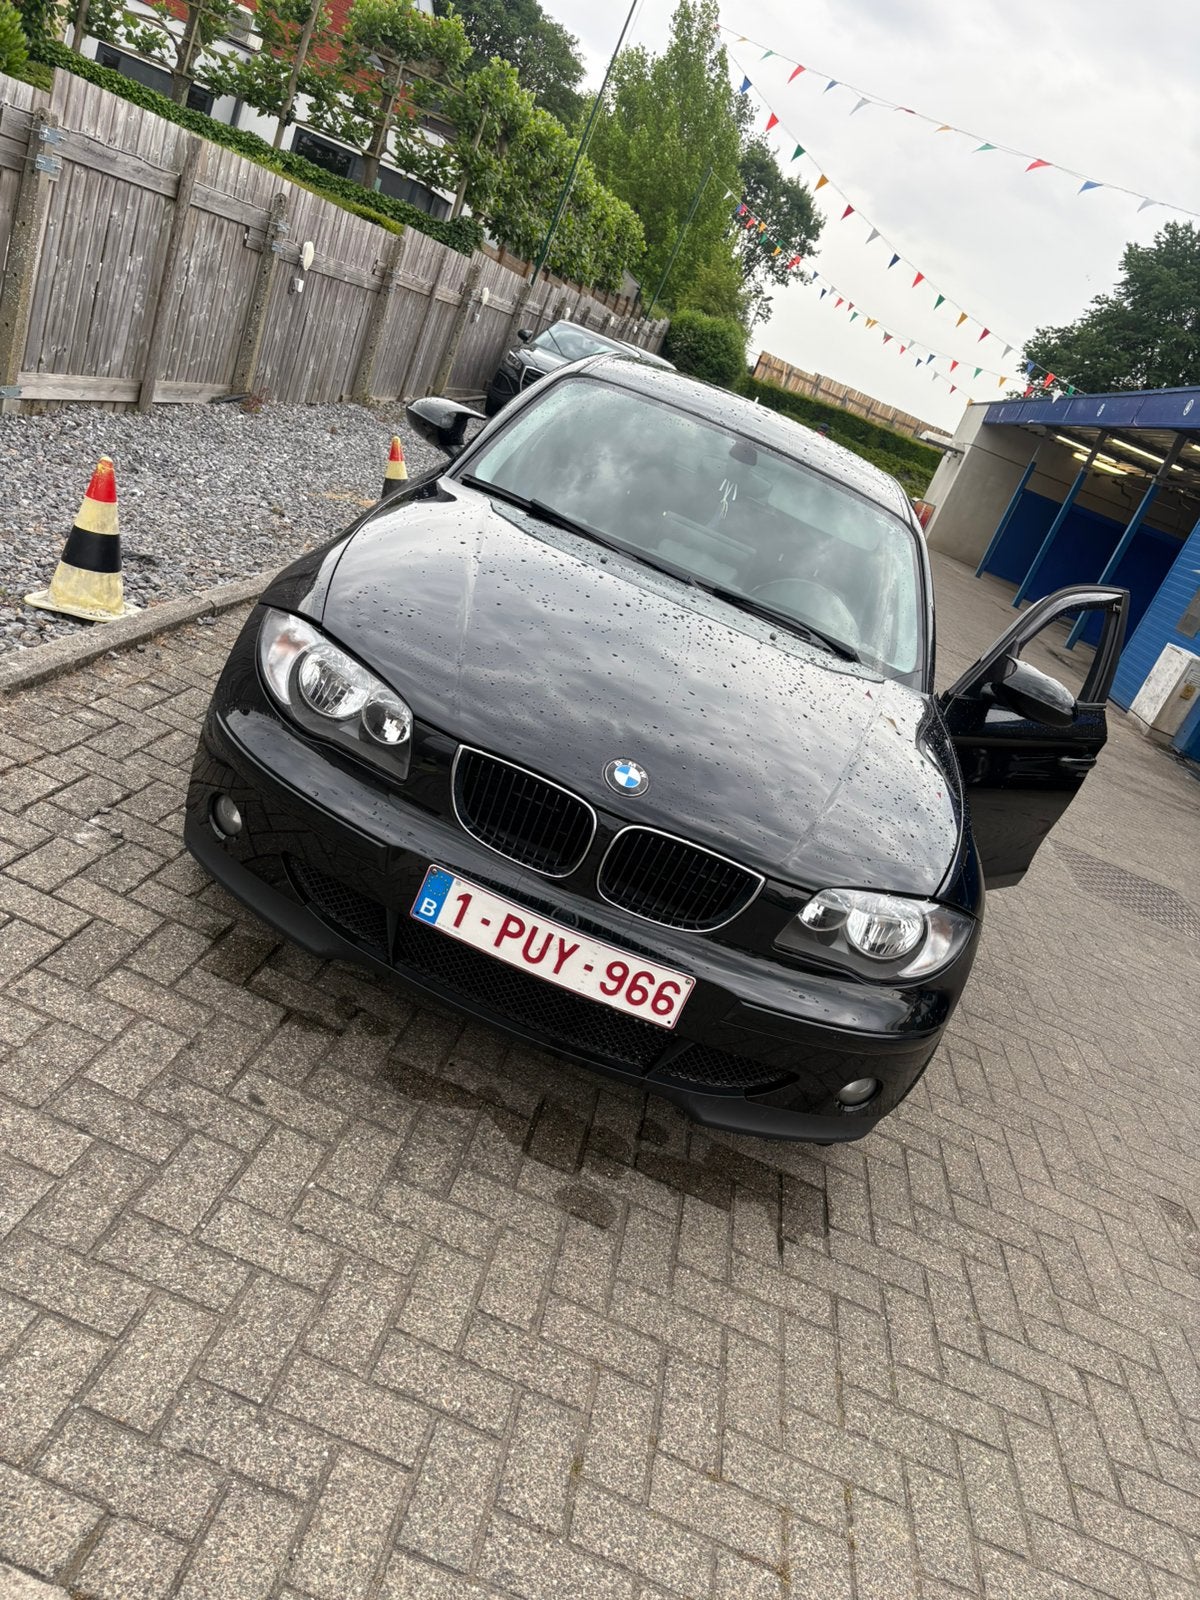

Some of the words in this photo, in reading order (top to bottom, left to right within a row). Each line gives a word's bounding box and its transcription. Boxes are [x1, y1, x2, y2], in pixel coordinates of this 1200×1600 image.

[614, 760, 648, 779] BMW
[420, 897, 437, 917] B
[453, 893, 681, 1016] 1-PUY-966
